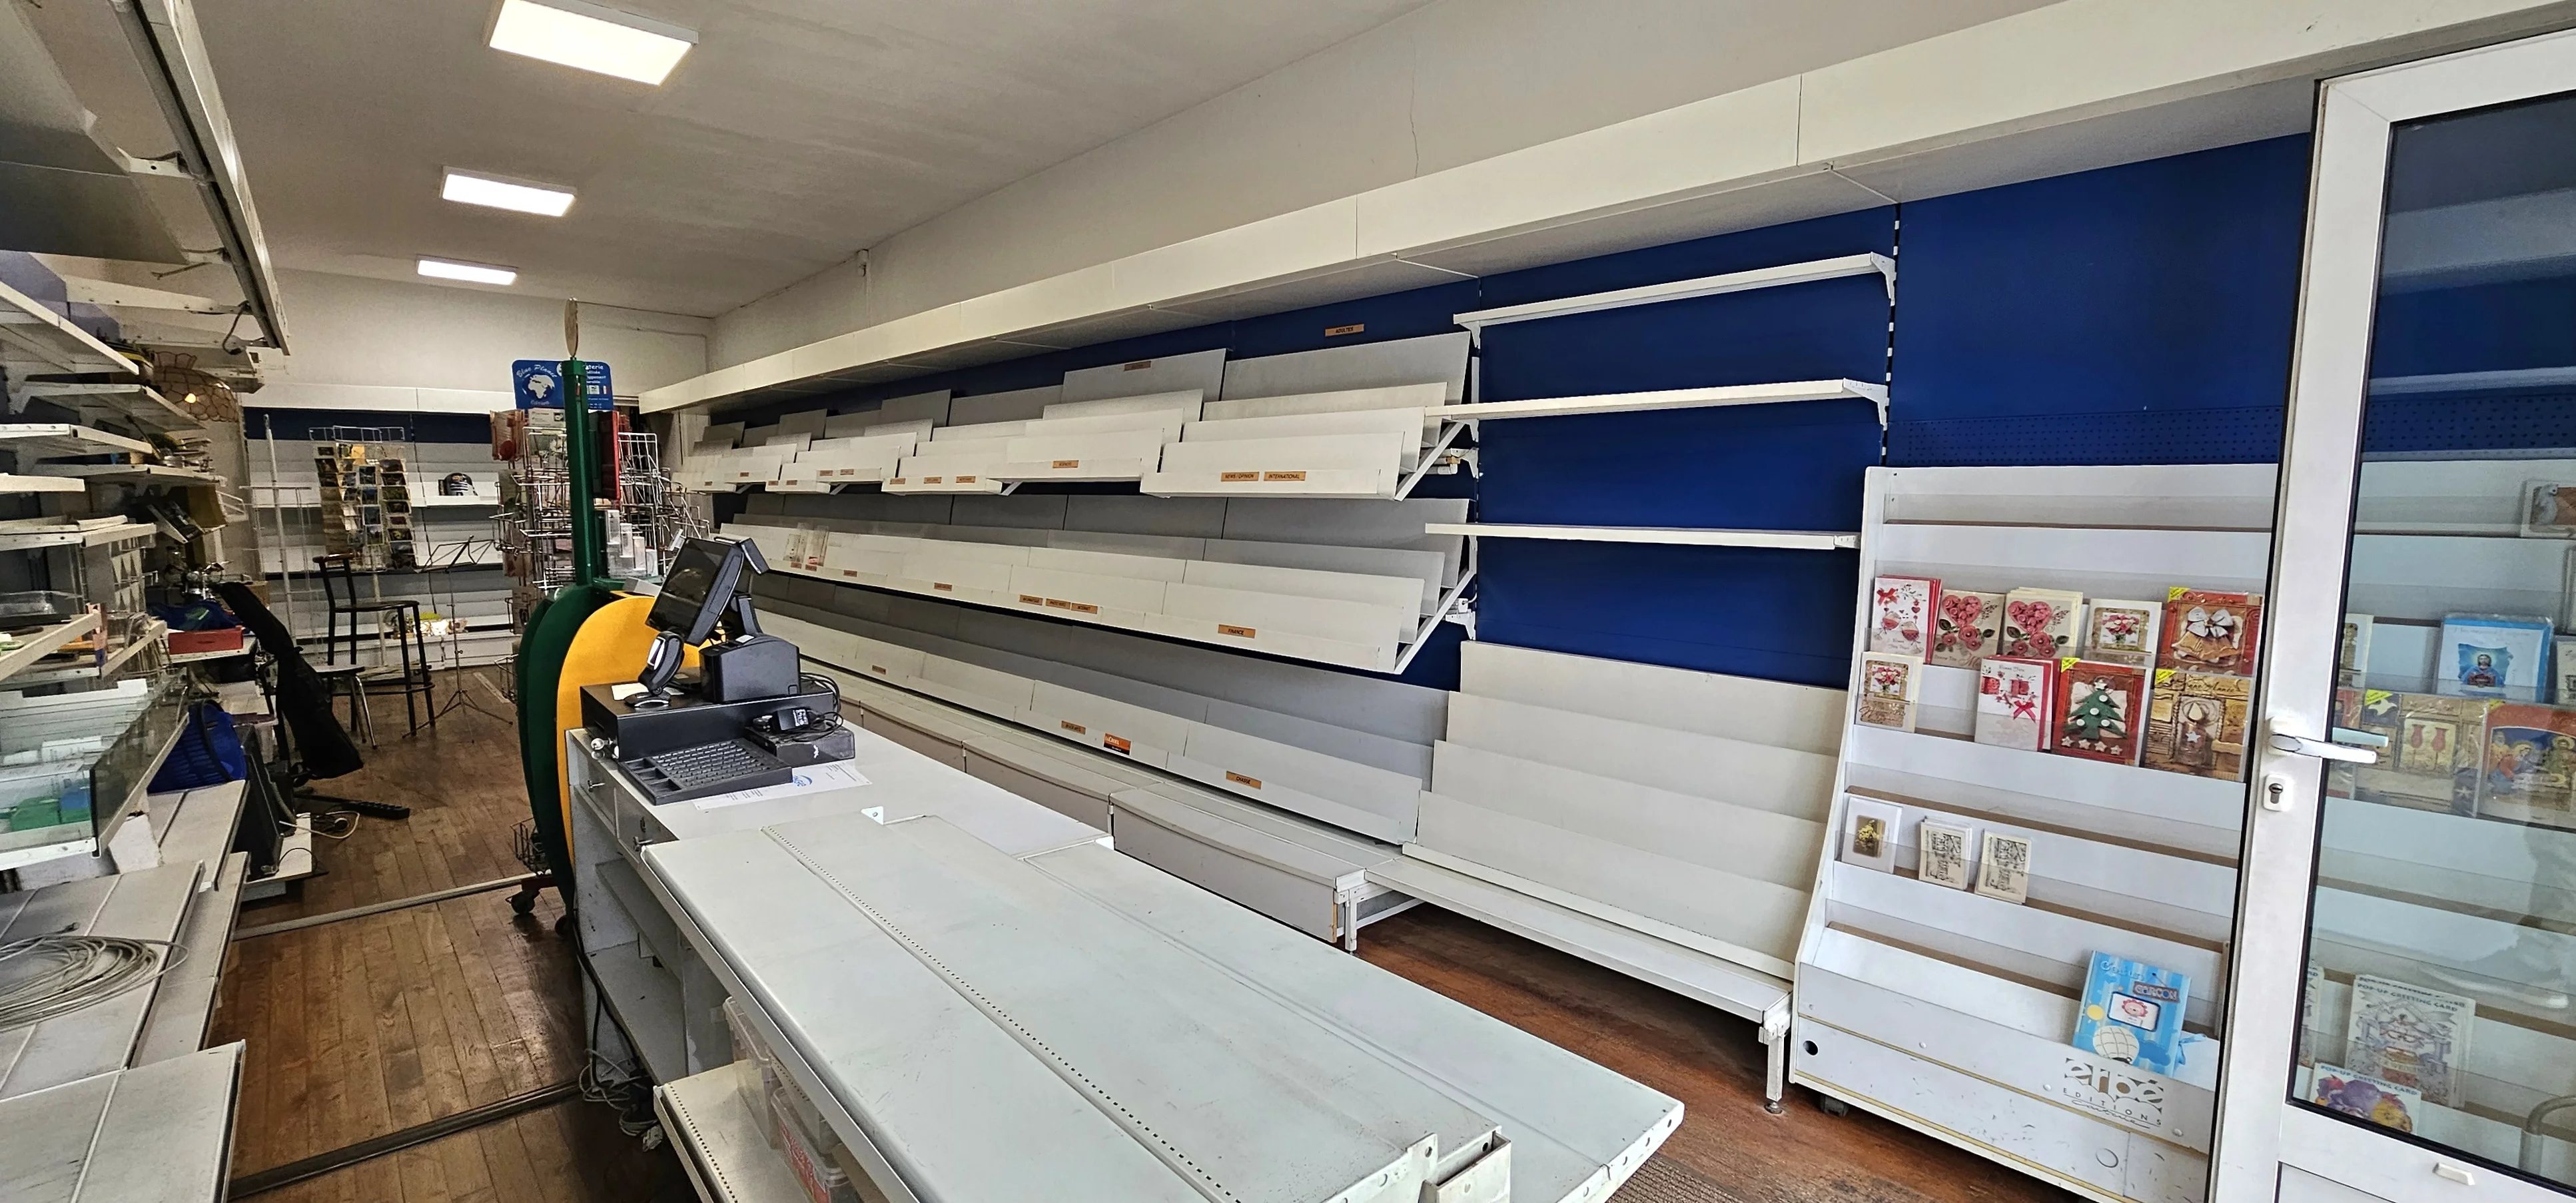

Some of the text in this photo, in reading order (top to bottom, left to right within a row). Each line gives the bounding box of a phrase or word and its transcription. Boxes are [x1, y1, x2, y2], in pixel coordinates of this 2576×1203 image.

[516, 367, 532, 378] Blue
[1236, 776, 1251, 785] CHASSE
[2358, 983, 2388, 994] POP-UP
[2390, 992, 2431, 1006] GREETING
[2433, 1002, 2458, 1012] CARD
[2320, 1065, 2418, 1096] POP-UP GREETING CARD
[2062, 1088, 2162, 1126] EDITIONS
